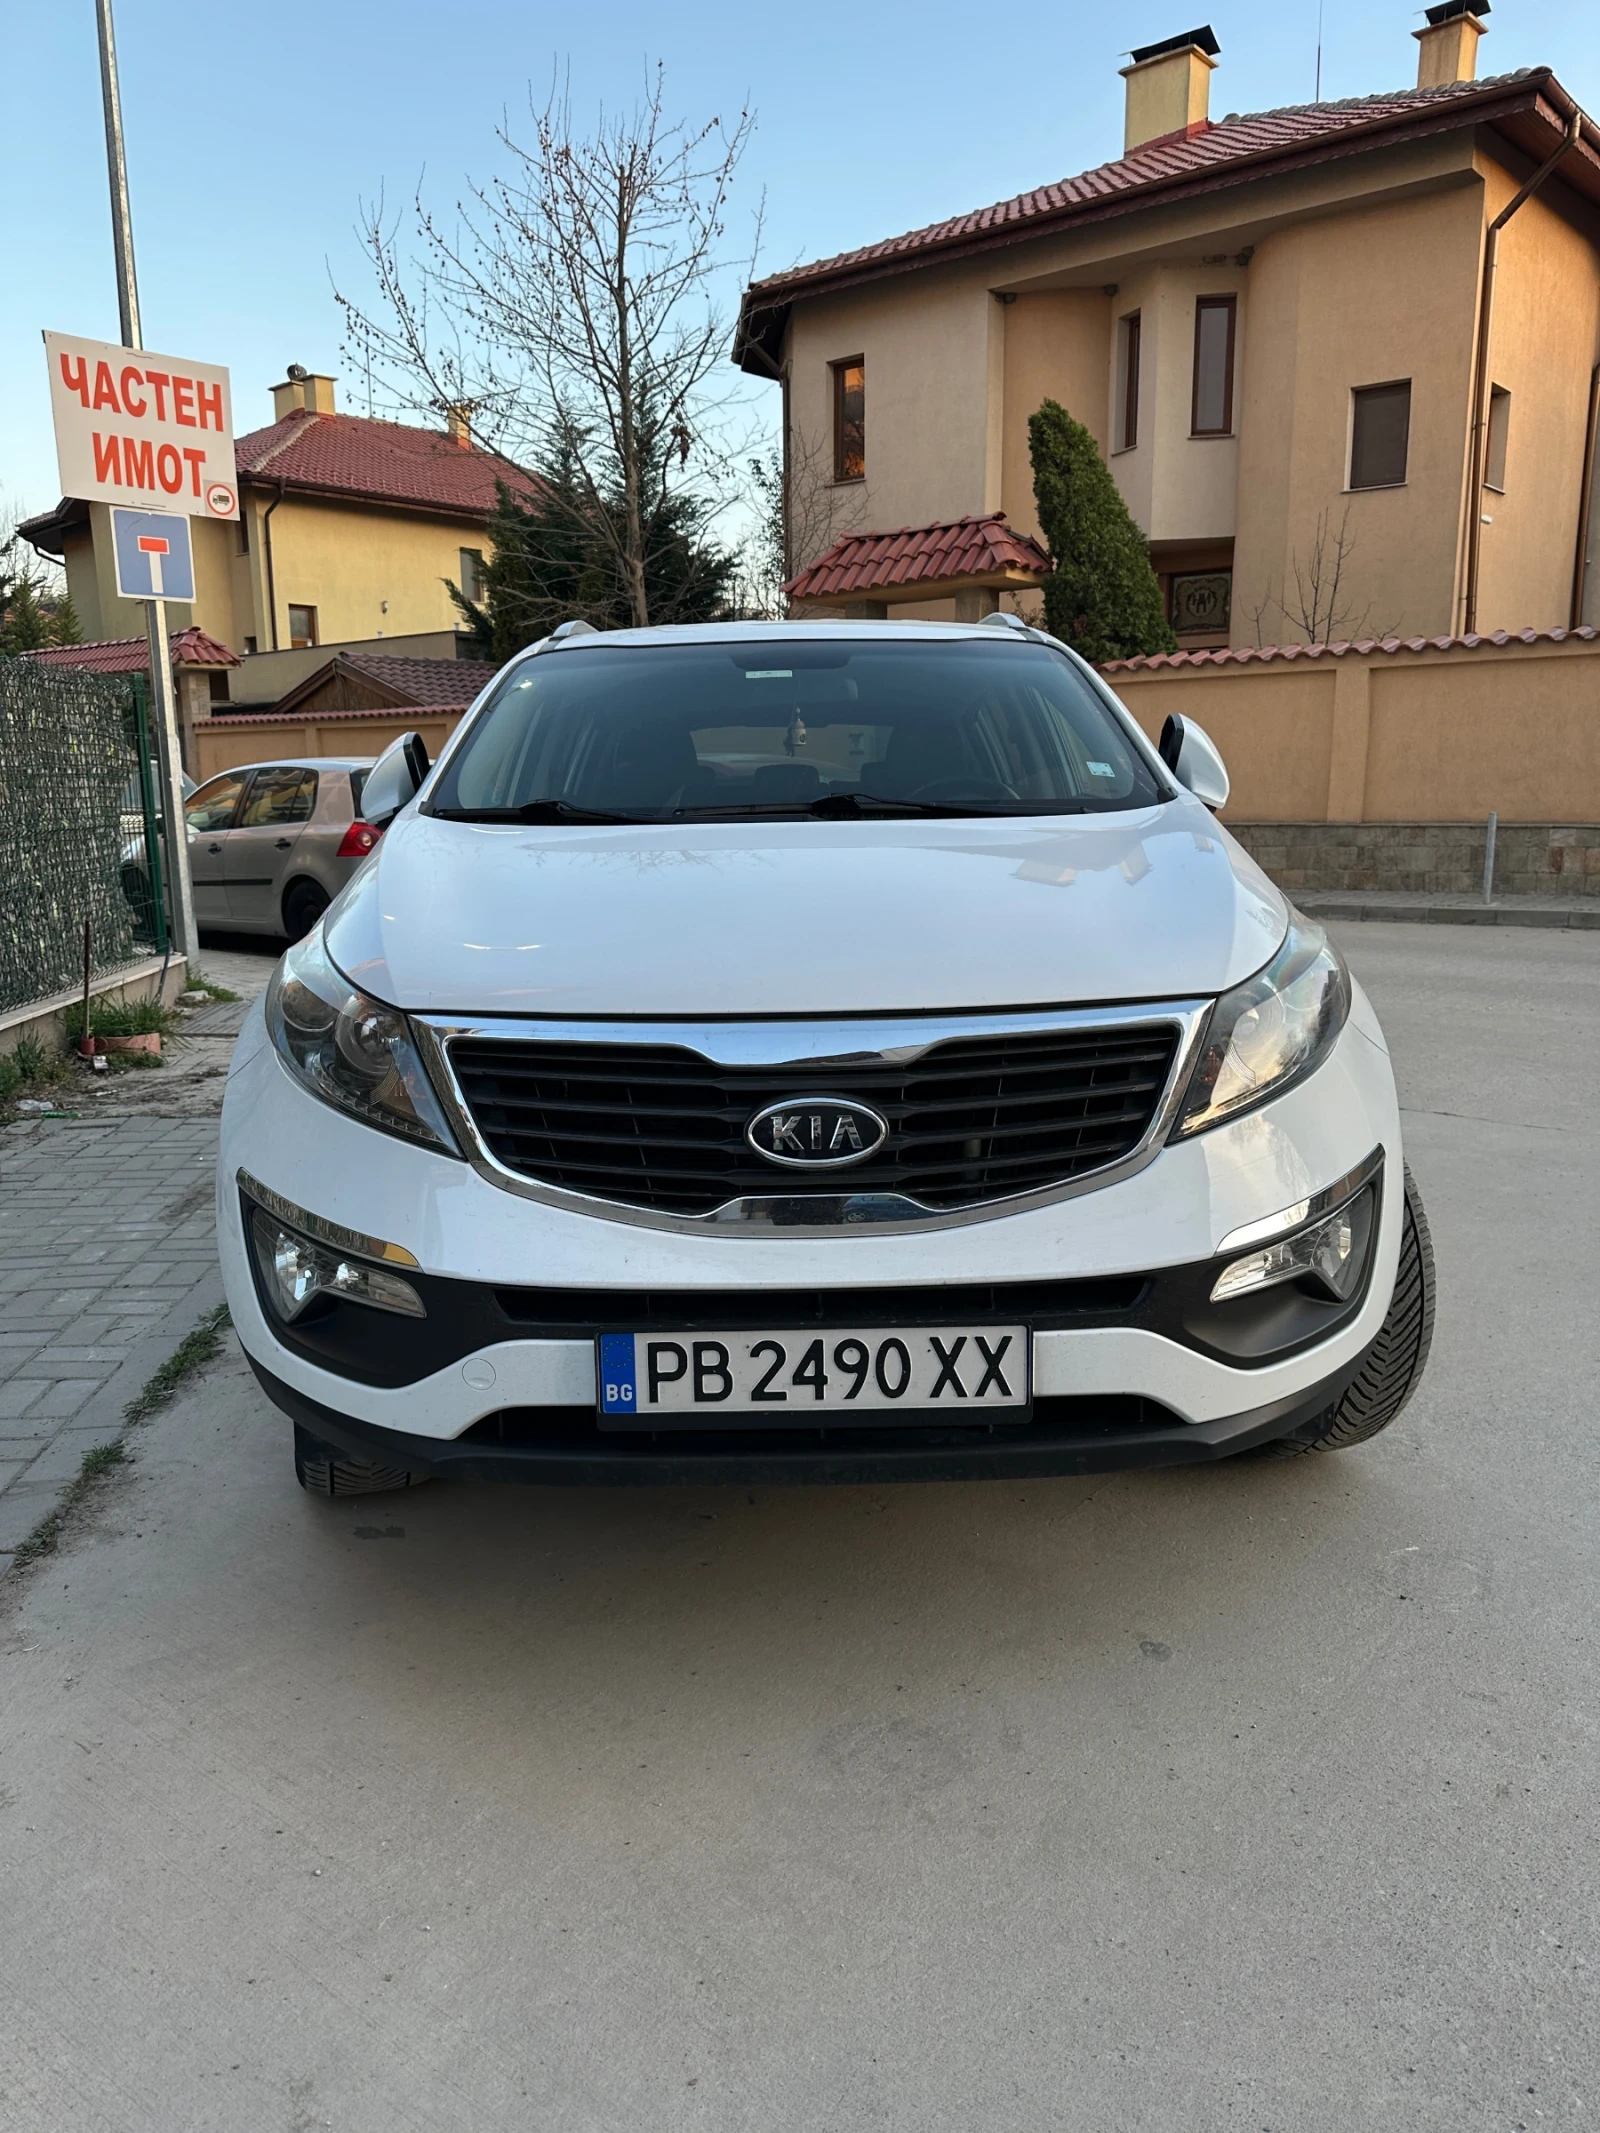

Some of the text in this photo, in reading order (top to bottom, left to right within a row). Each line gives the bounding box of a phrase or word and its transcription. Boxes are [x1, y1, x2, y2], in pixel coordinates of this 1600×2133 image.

[60, 353, 224, 433] ЧАСТЕН
[92, 432, 207, 498] ИМОТ
[770, 1114, 863, 1151] KIA
[606, 1384, 633, 1402] BG
[647, 1336, 1013, 1403] PB 2490 XX
